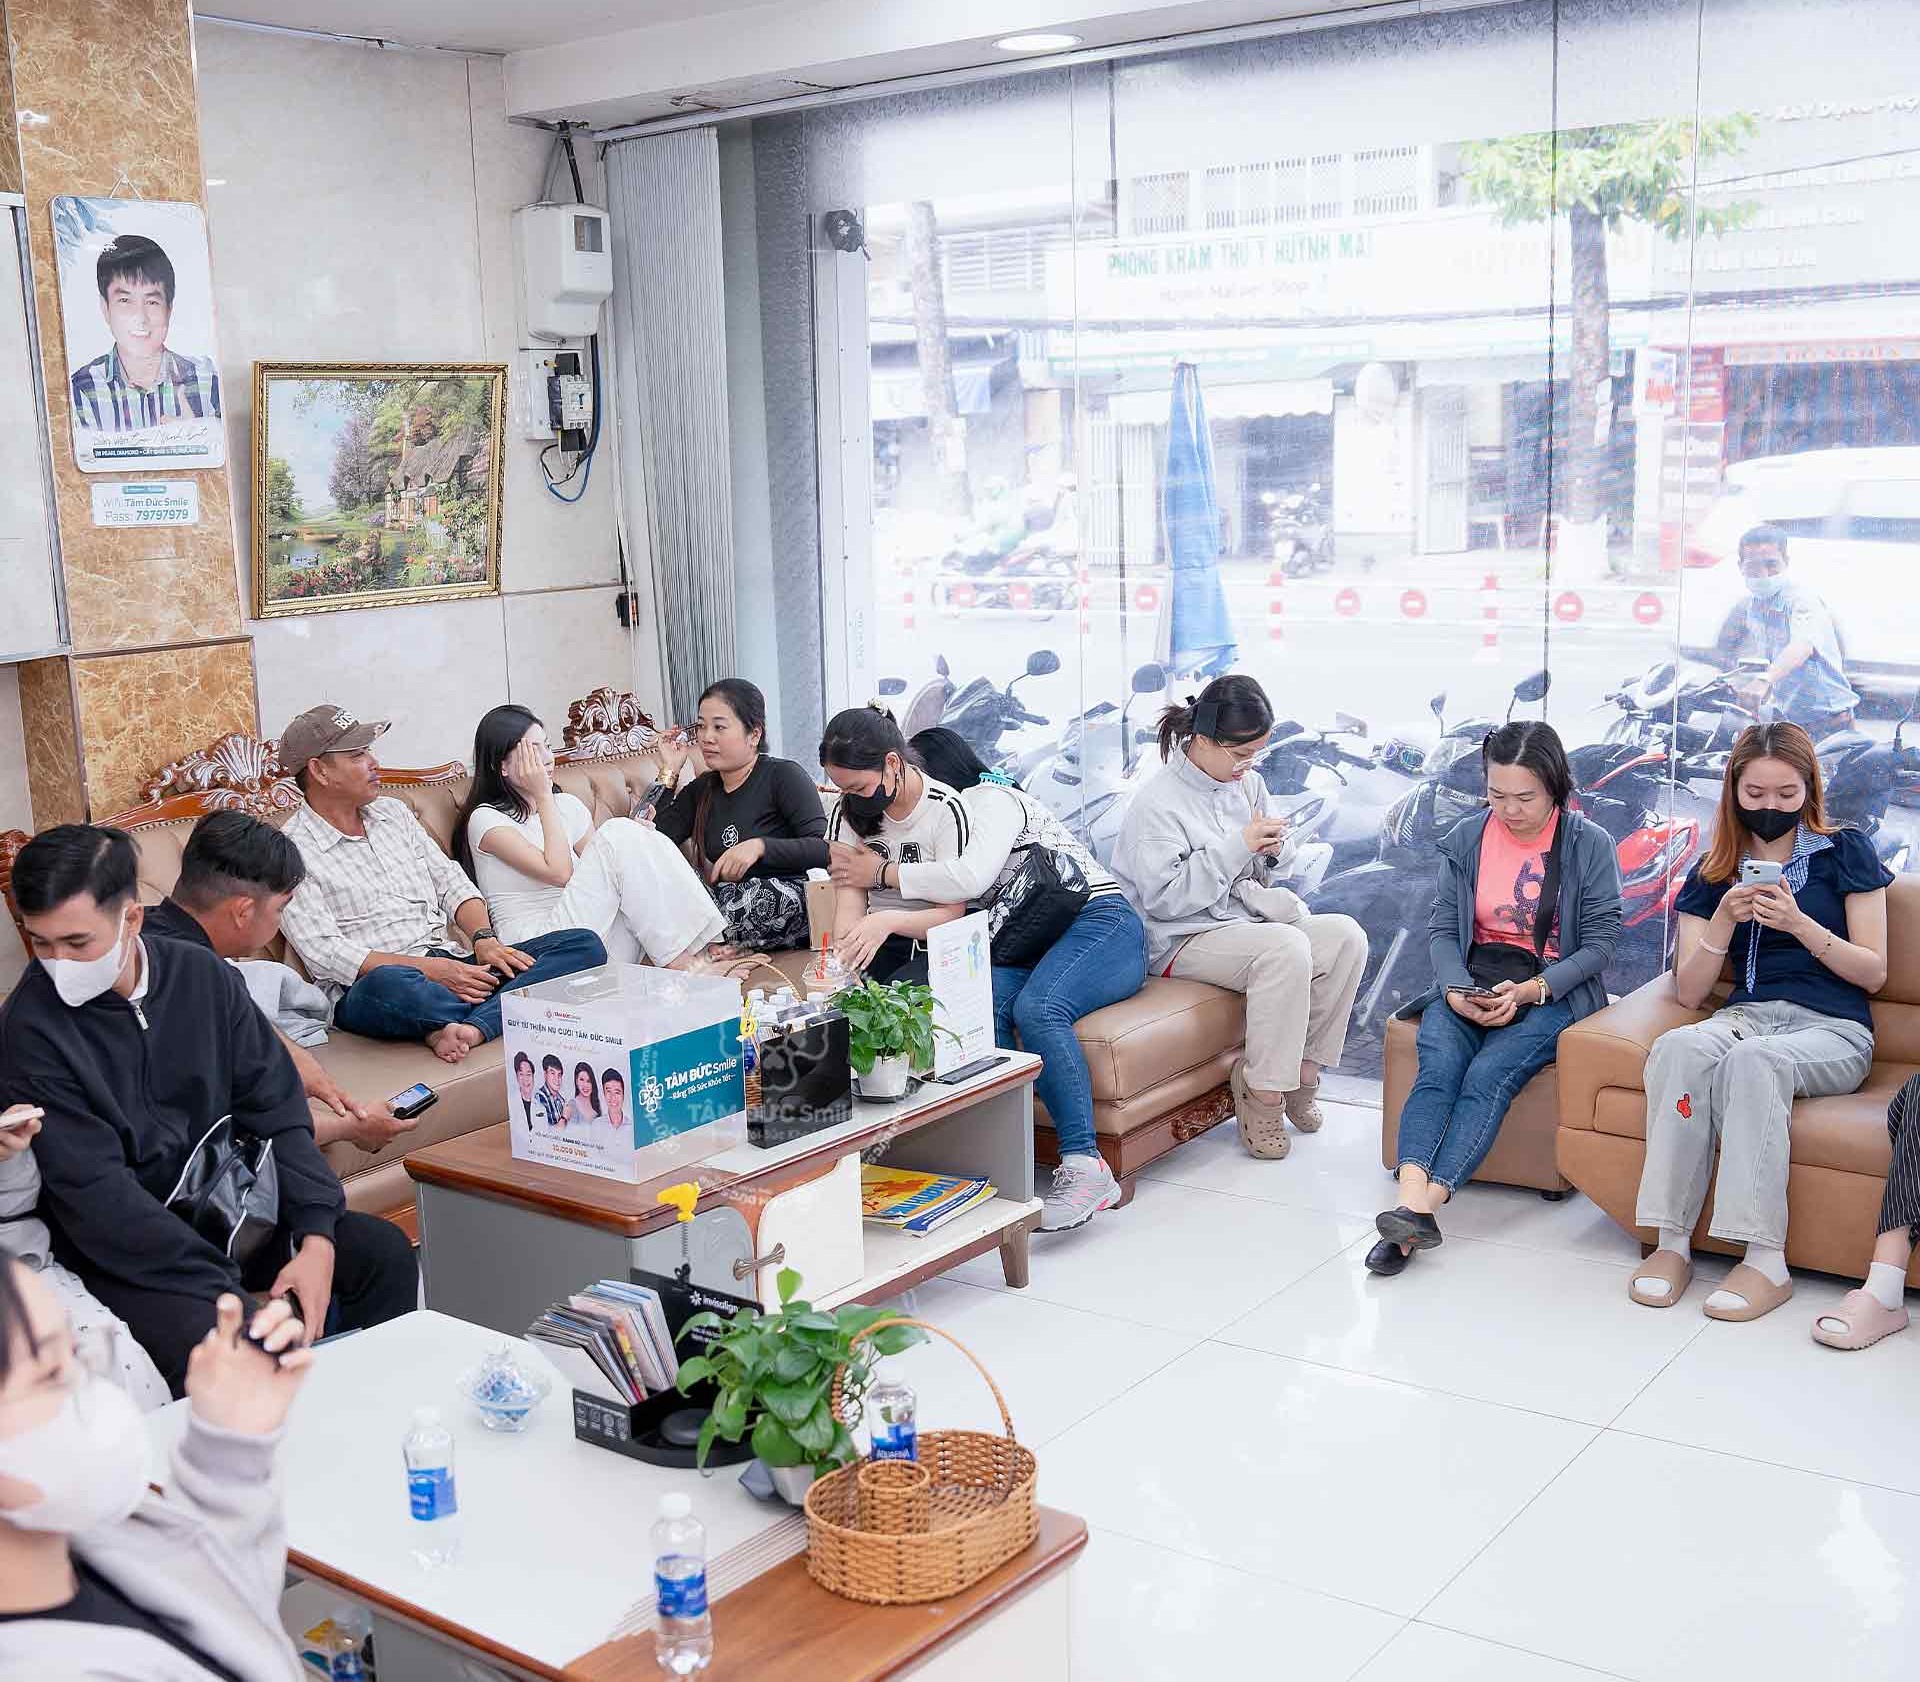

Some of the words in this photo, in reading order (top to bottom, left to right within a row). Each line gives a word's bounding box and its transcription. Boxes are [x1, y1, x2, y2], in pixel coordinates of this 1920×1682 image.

[164, 498, 189, 507] Smile
[136, 509, 189, 521] 79797979
[664, 1071, 688, 1090] TÂM
[689, 1061, 714, 1082] ĐỨC
[713, 1057, 737, 1075] Smile
